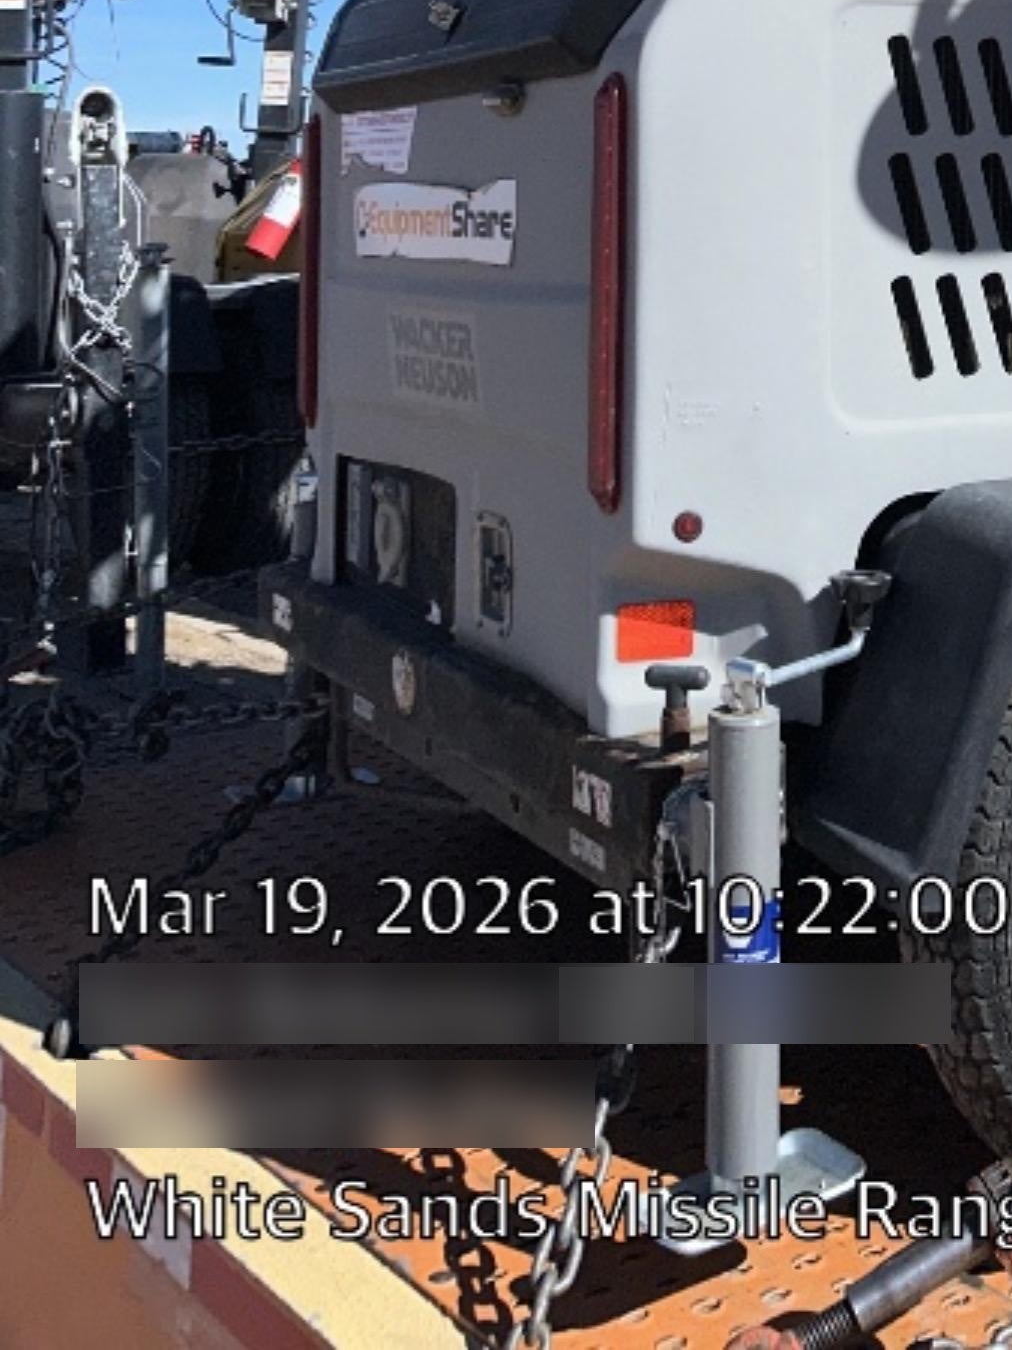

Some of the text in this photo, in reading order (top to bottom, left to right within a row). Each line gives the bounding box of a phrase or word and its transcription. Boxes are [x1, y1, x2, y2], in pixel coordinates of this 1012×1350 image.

[370, 201, 513, 243] EquipmentShare
[391, 314, 474, 361] WACKER
[395, 353, 478, 402] NEUSON
